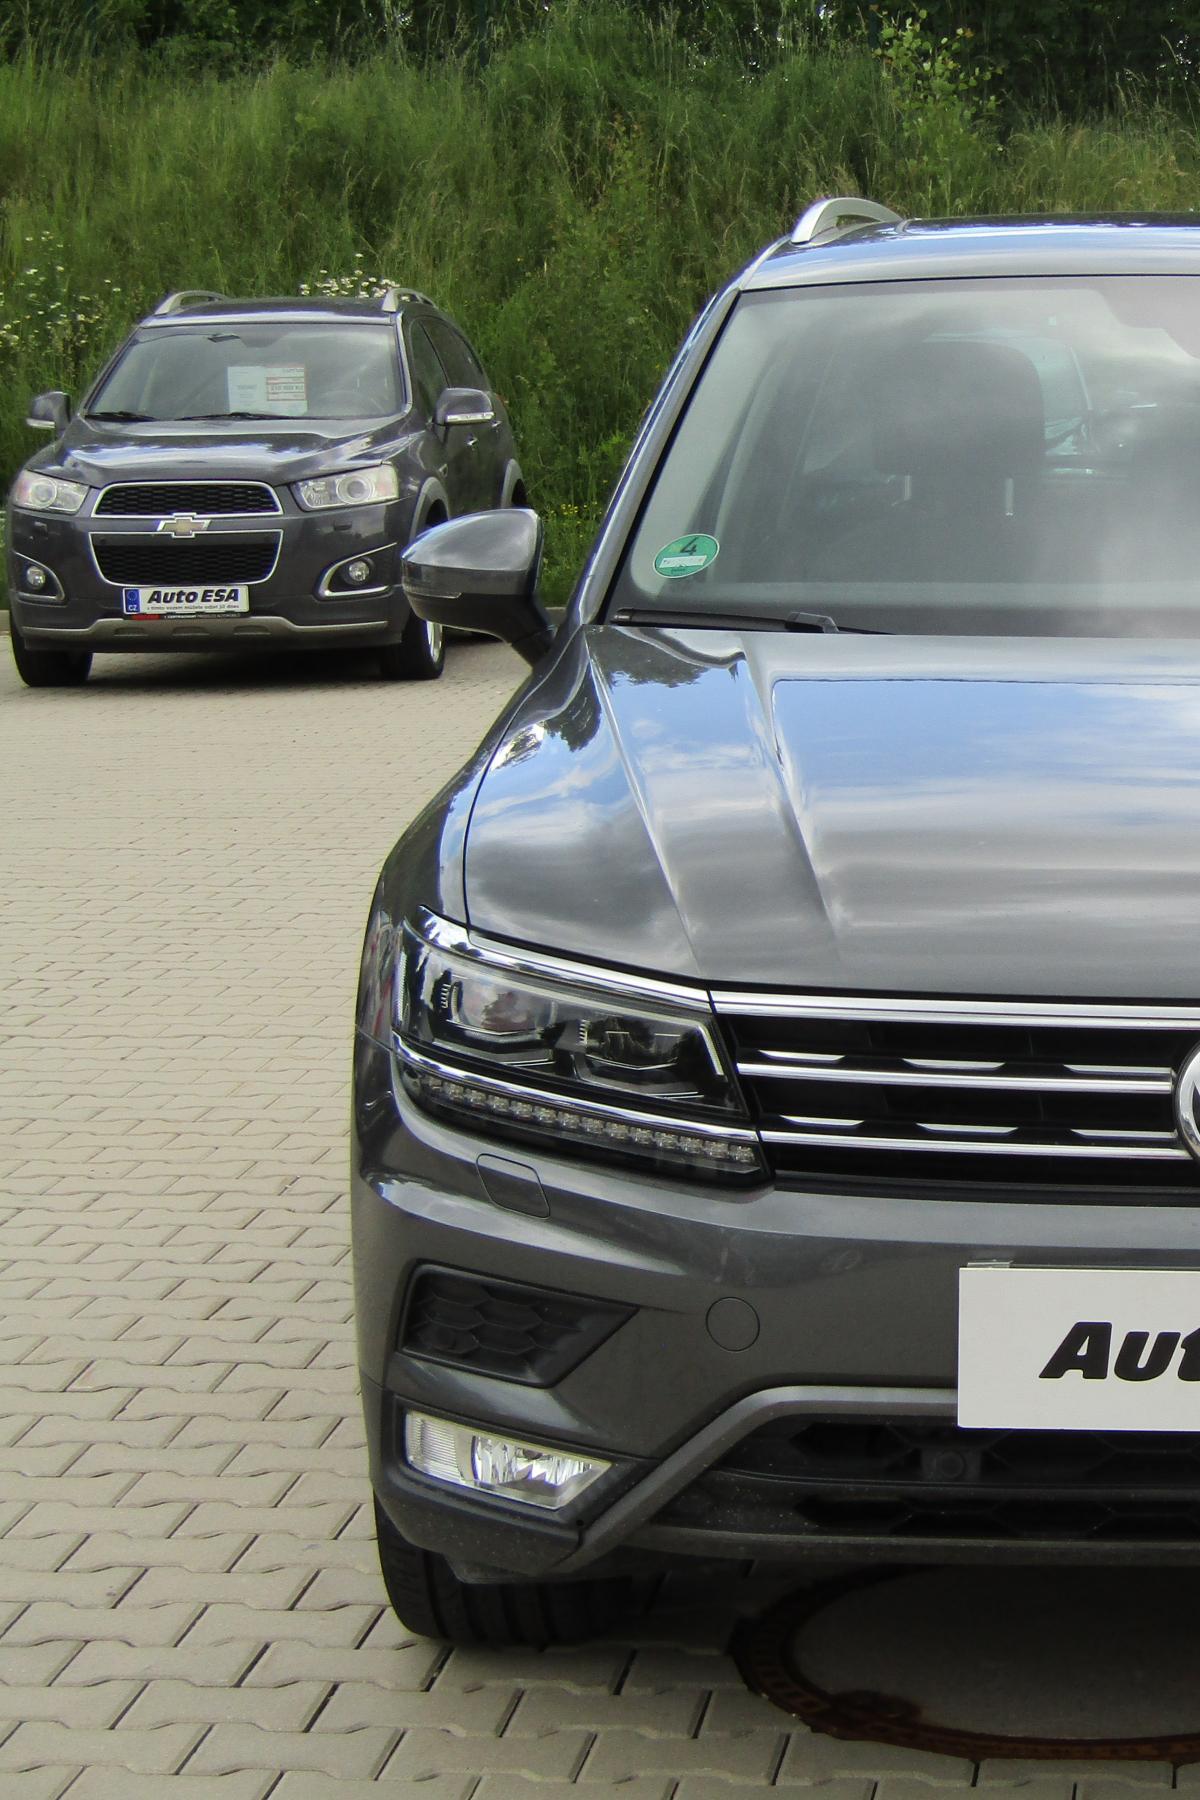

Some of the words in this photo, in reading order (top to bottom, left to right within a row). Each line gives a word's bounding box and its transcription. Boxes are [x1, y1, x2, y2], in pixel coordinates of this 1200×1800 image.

[680, 536, 700, 556] 4
[147, 590, 199, 604] Auto
[201, 588, 239, 603] ESA
